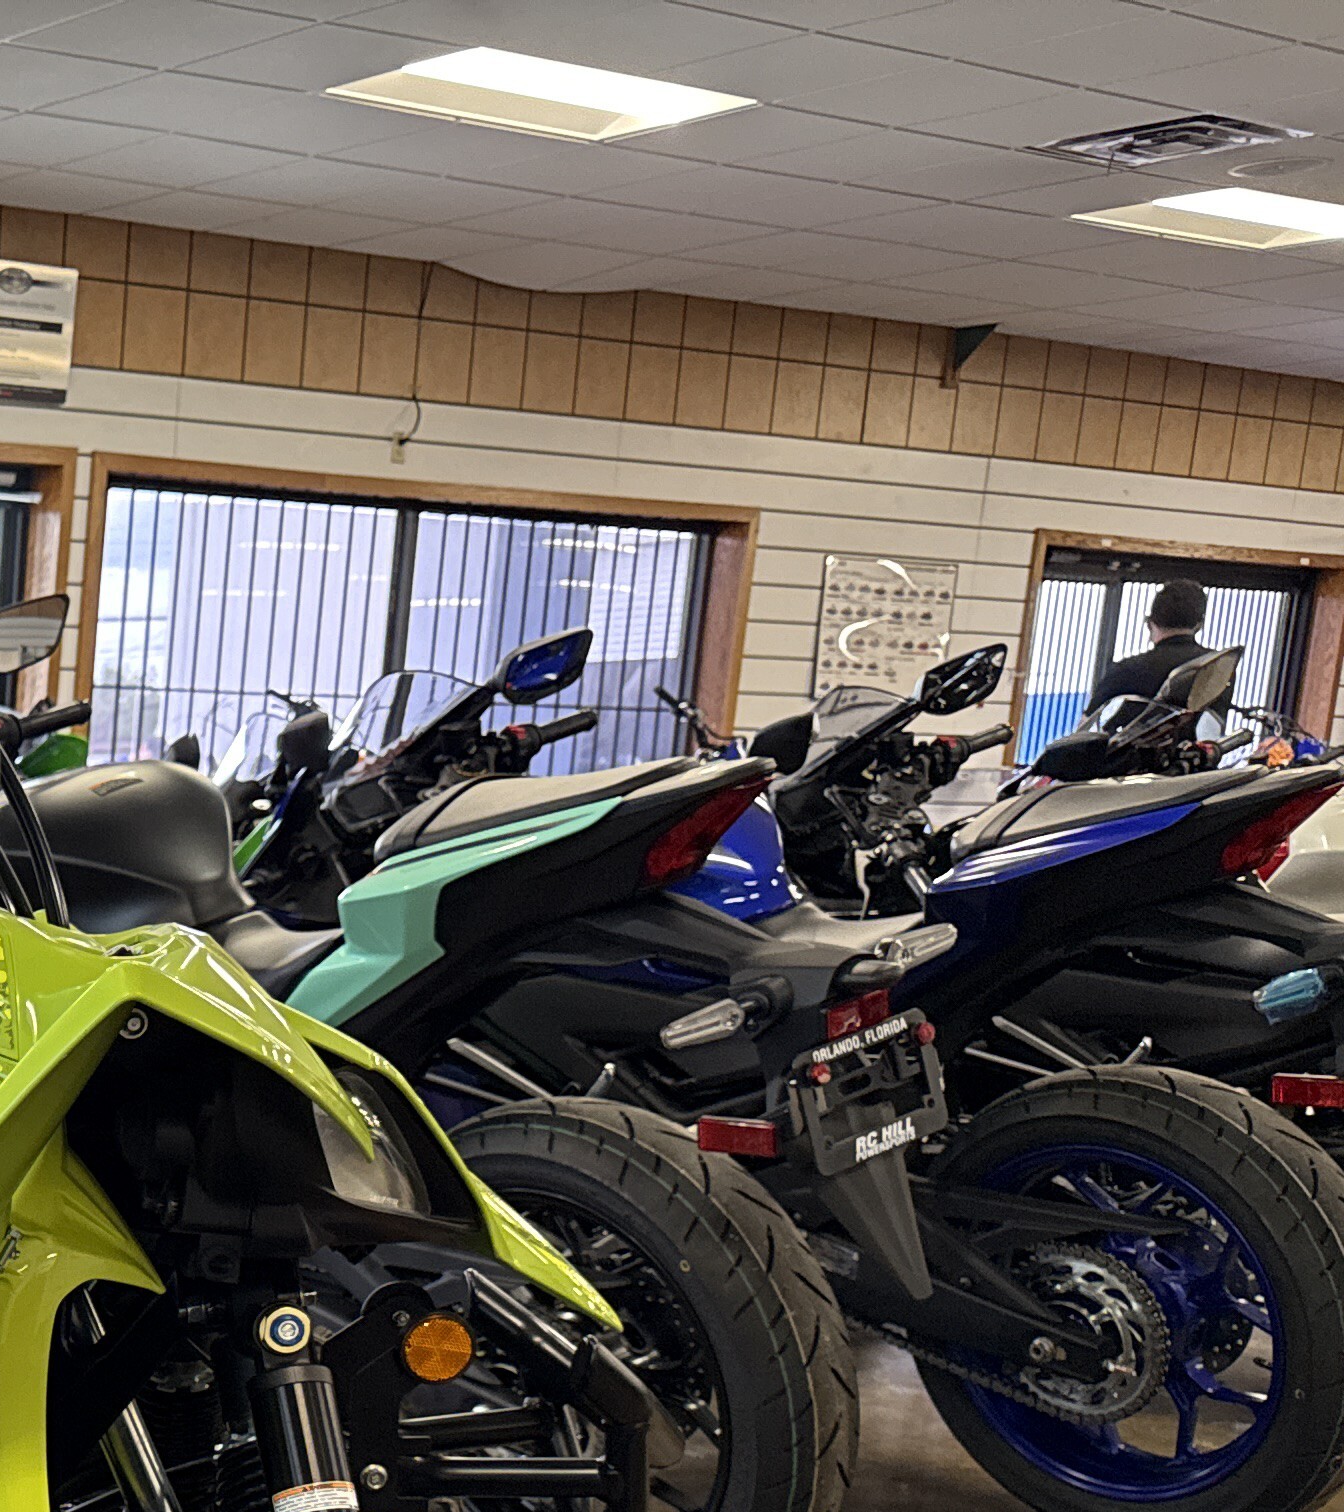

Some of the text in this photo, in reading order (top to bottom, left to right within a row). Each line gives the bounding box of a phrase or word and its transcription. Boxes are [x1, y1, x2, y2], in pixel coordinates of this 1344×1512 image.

[812, 1017, 908, 1063] ORLANDO, FLORIDA
[855, 1117, 914, 1150] RC HILL
